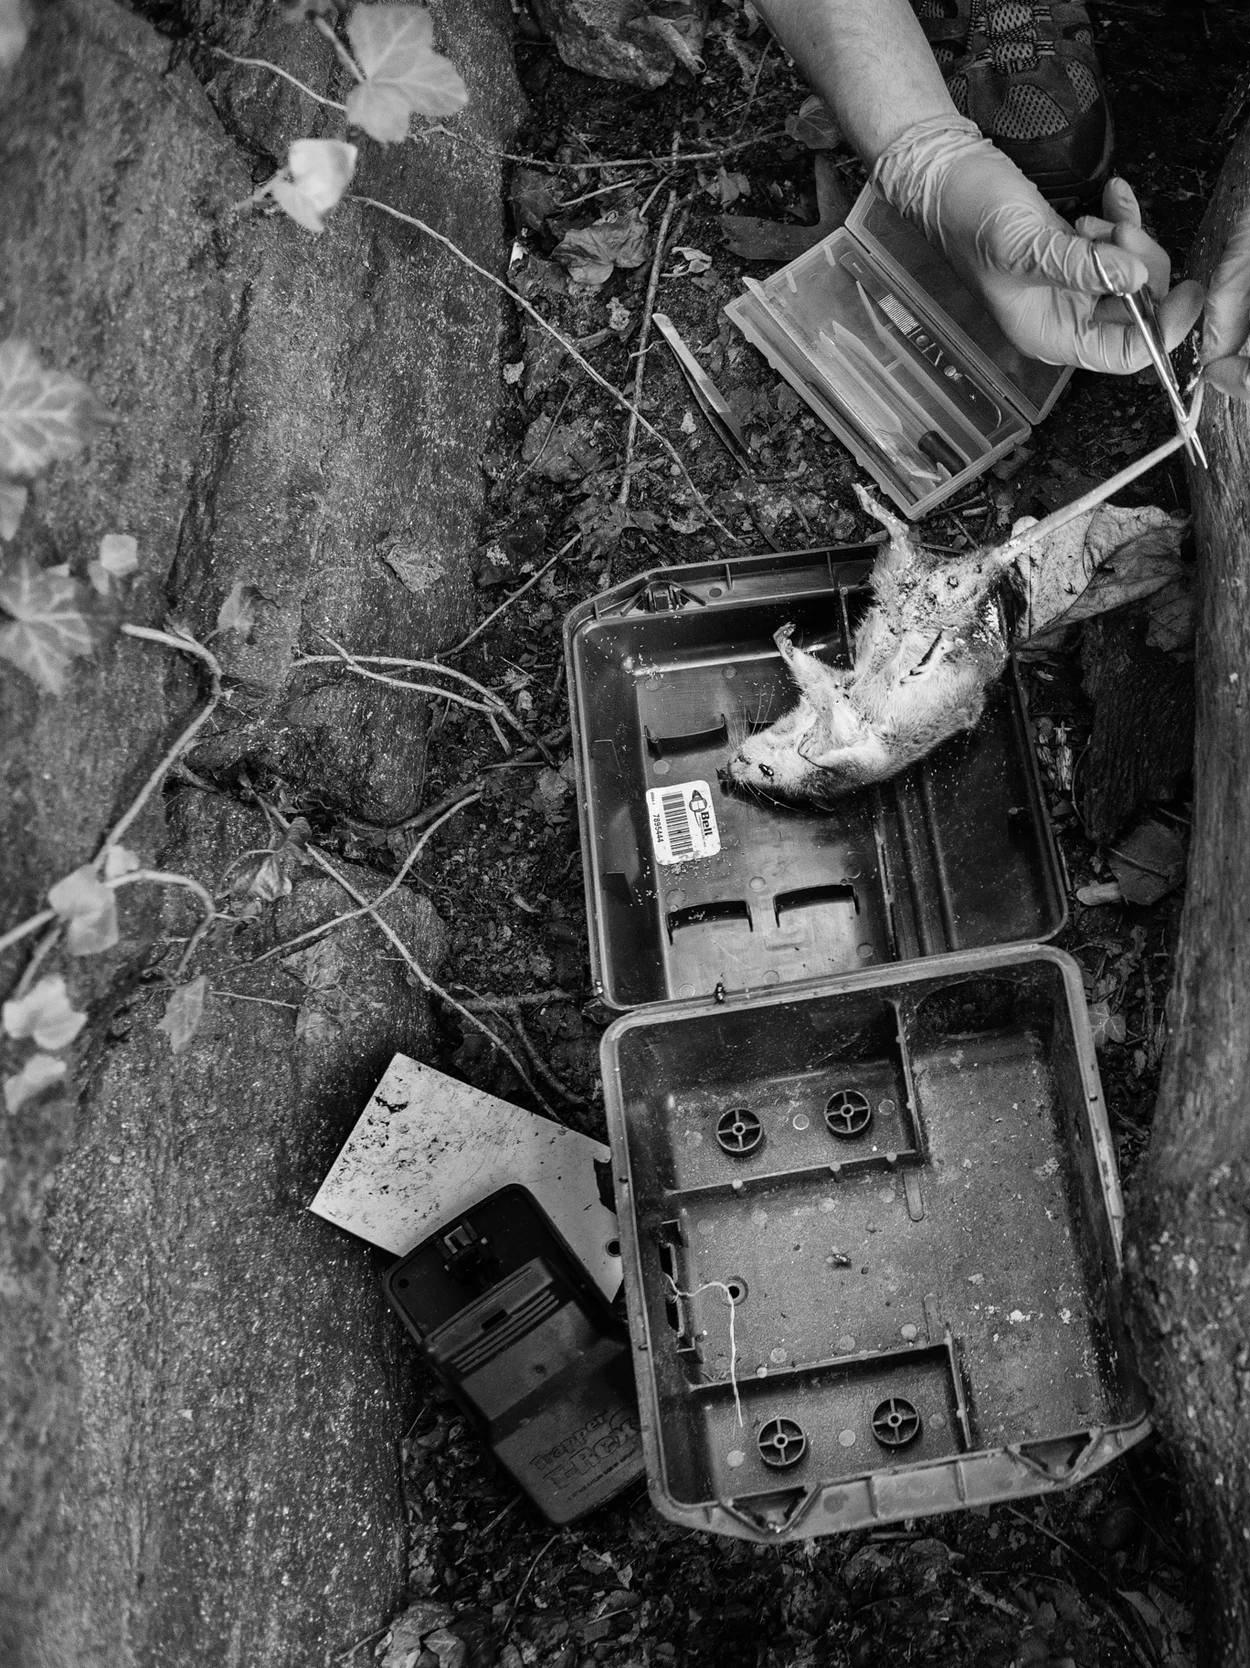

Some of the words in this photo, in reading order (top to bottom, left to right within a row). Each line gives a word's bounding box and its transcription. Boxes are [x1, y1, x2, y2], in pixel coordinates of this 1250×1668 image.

[652, 814, 664, 843] 7895444
[701, 811, 713, 836] Bell
[529, 1410, 609, 1470] Trapper
[542, 1418, 641, 1490] T-Rex
